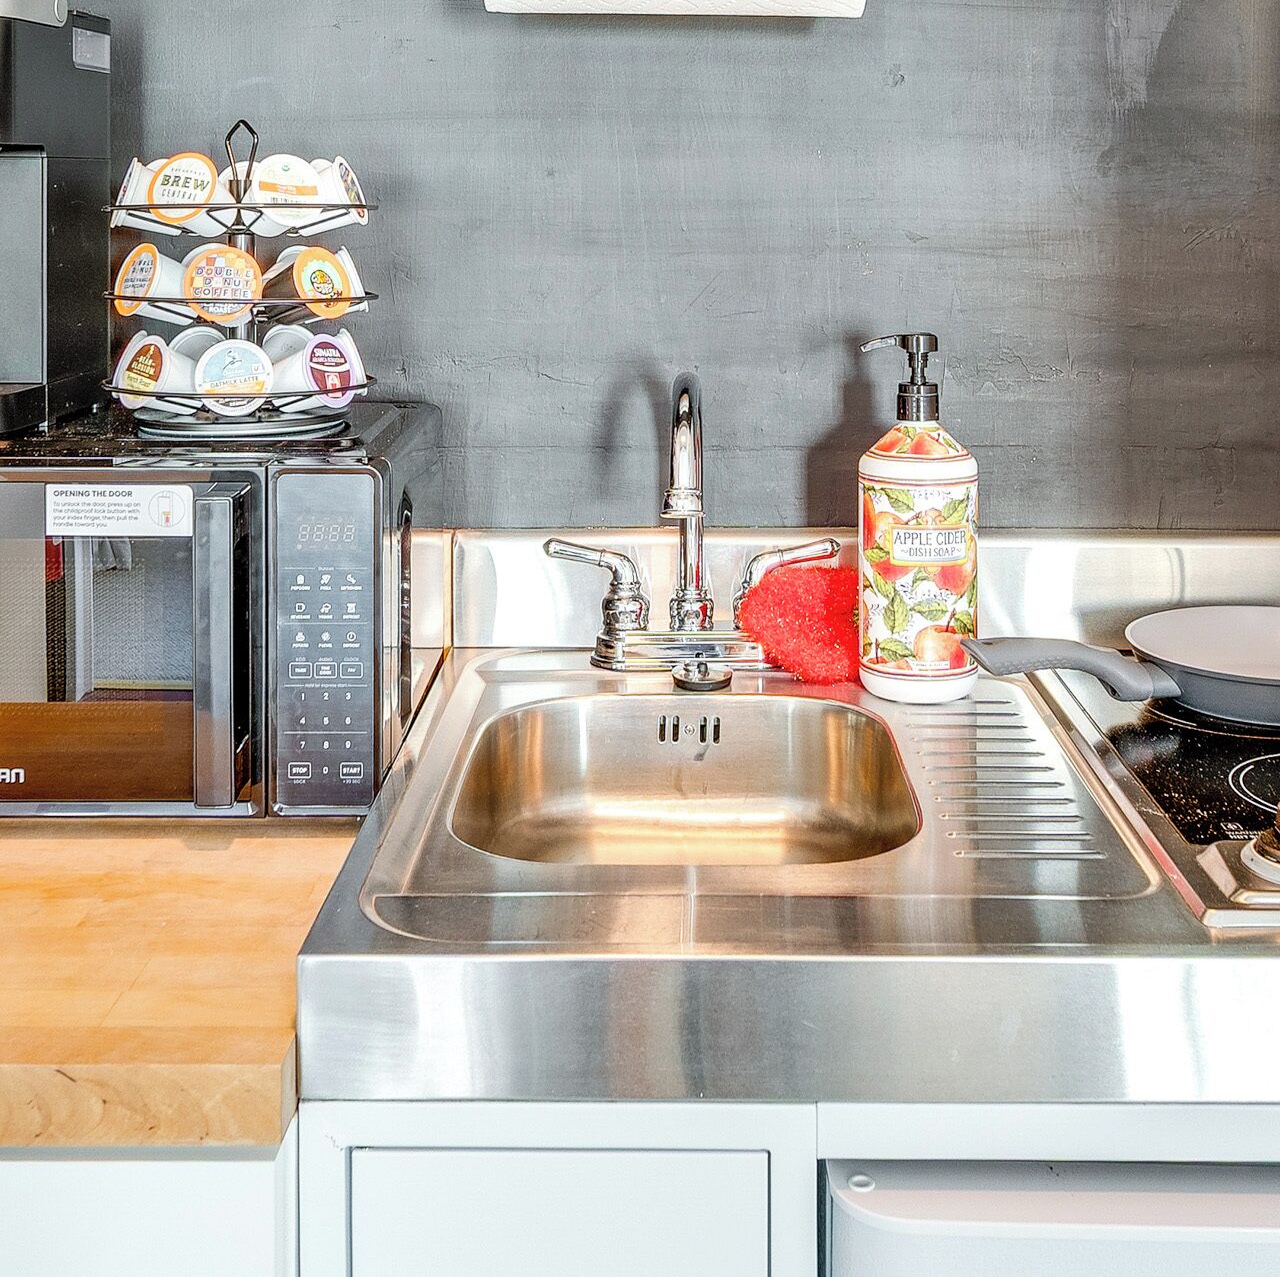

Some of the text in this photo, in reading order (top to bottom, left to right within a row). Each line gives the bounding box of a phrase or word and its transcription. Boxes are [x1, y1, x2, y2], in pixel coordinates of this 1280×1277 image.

[160, 174, 210, 192] BREW
[195, 266, 252, 278] DOUBLE
[193, 287, 251, 298] COFFEE
[239, 375, 259, 384] LATTE
[894, 530, 967, 546] APPLE CIDER
[908, 546, 956, 557] DISH SOAP
[301, 692, 305, 701] 1
[323, 692, 329, 700] 2
[345, 692, 351, 700] 3
[300, 716, 306, 725] 4
[323, 716, 329, 725] 5
[345, 716, 351, 725] 6
[300, 740, 306, 749] 7
[323, 740, 329, 749] 8
[345, 740, 351, 749] 9
